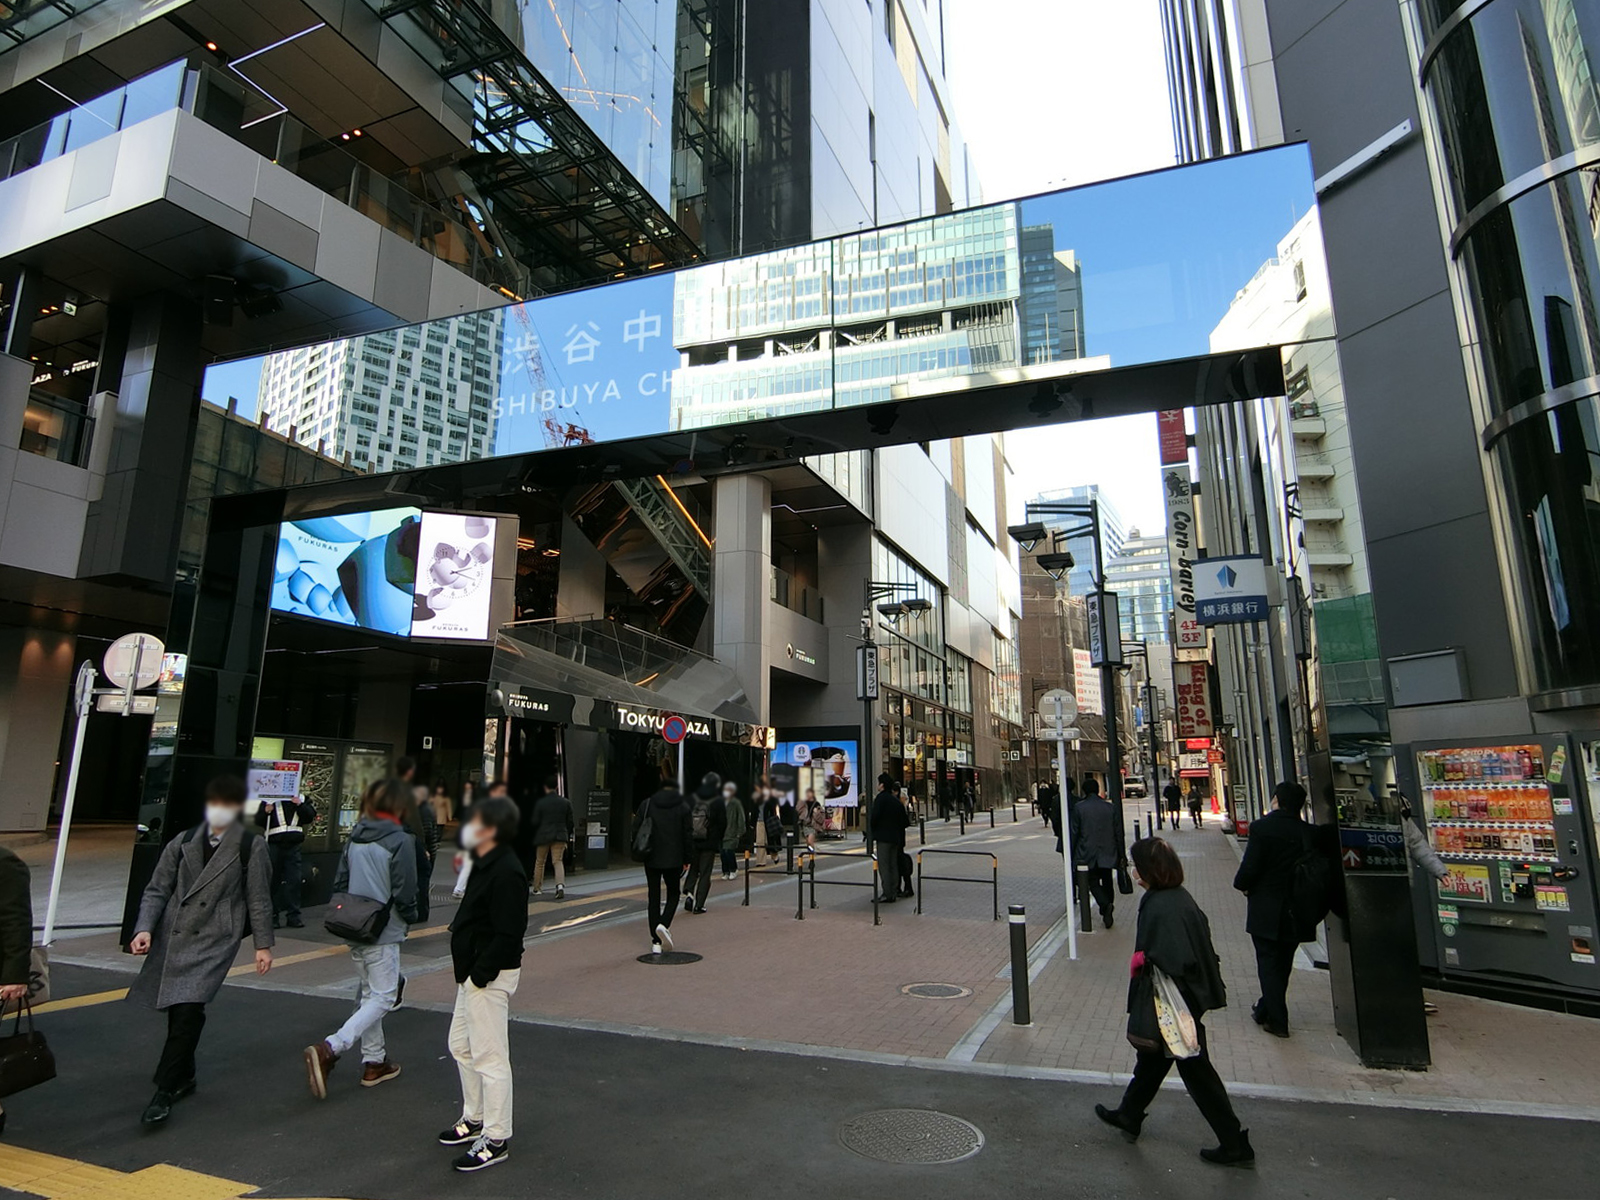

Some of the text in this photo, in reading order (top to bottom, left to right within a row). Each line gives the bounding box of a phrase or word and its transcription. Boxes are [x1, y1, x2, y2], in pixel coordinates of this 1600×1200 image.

[490, 378, 622, 420] SHIBUYA
[298, 536, 338, 552] FUKURAS
[1202, 601, 1258, 617] 横浜銀行
[1088, 601, 1100, 657] 東急プラザ
[1181, 632, 1202, 643] 3F
[867, 651, 876, 693] 東急プラザ
[1190, 664, 1206, 705] King
[508, 699, 549, 711] FUKURAS
[617, 708, 666, 730] TOKYU
[1195, 708, 1211, 727] of
